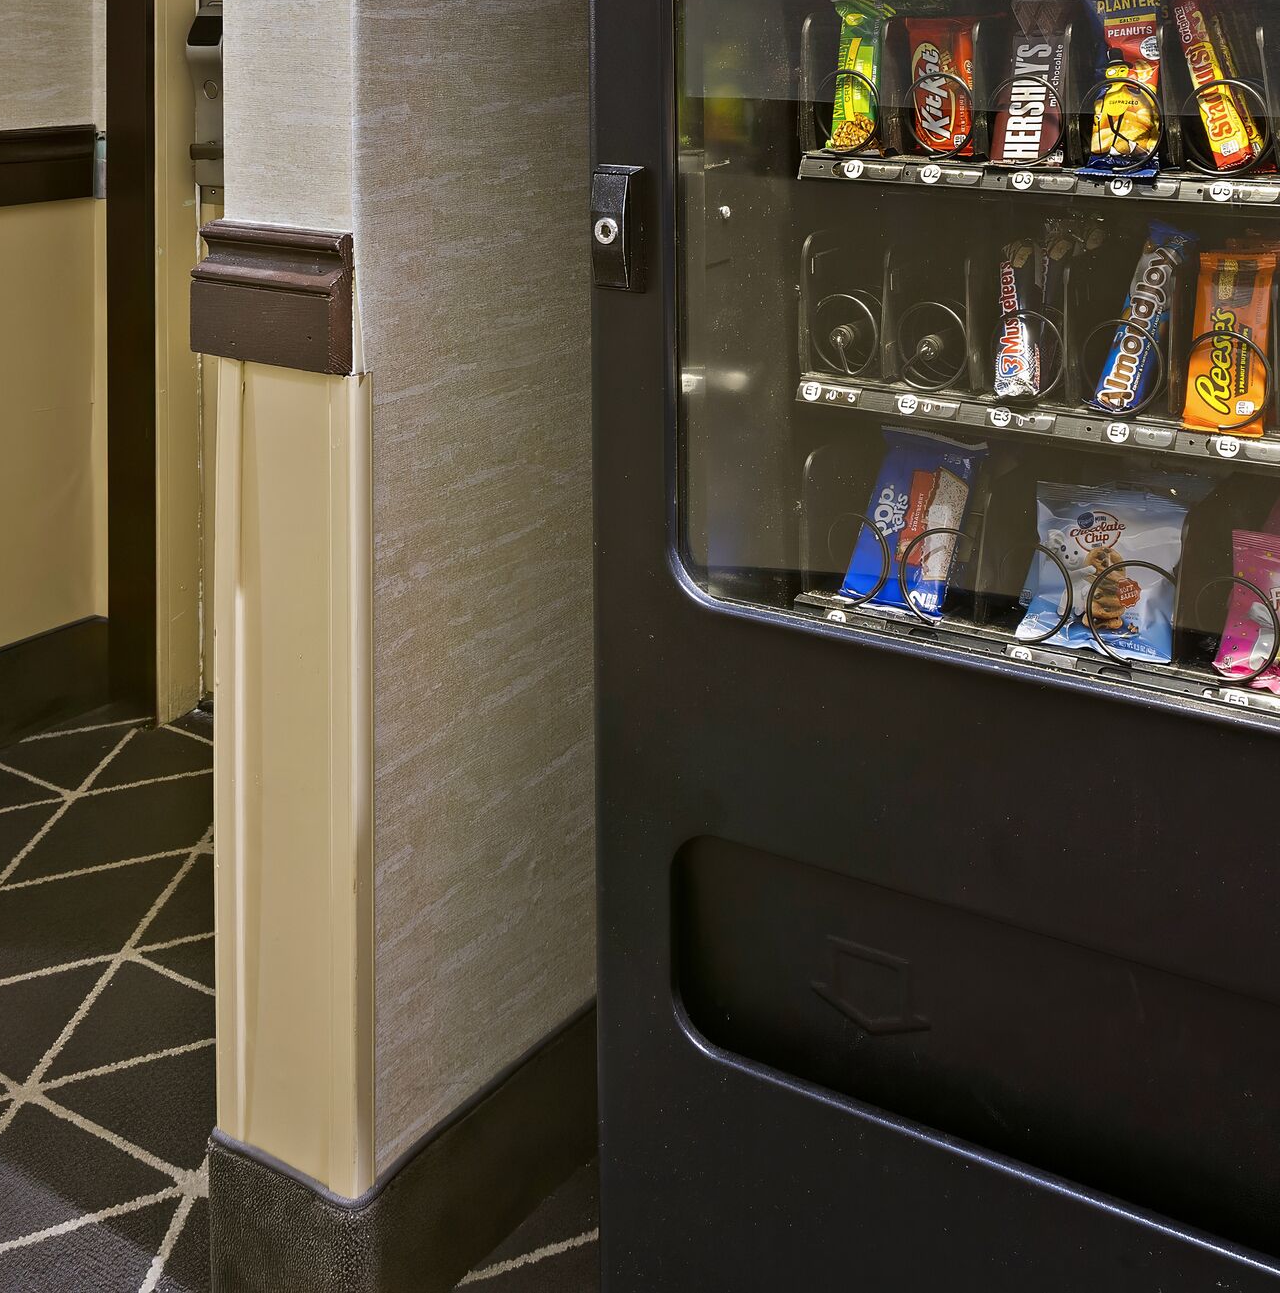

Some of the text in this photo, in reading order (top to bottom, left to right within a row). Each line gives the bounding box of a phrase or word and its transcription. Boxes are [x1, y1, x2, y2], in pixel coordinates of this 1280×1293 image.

[1108, 25, 1153, 37] PEANUTS
[1050, 44, 1064, 86] chocolate
[844, 57, 853, 103] CRUNHY
[923, 168, 939, 178] D2
[1015, 175, 1031, 184] D3
[1113, 180, 1131, 190] D4
[1136, 248, 1181, 303] Joy
[1096, 295, 1157, 409] Almond
[1001, 357, 1023, 375] 3
[1194, 308, 1237, 414] Reese's
[805, 386, 819, 396] E1
[902, 397, 917, 409] E2
[994, 411, 1010, 421] E3
[1110, 426, 1126, 437] E4
[1220, 440, 1237, 451] E5
[890, 493, 908, 533] tarts
[1070, 521, 1126, 537] Chocolate
[1085, 532, 1110, 544] Chip
